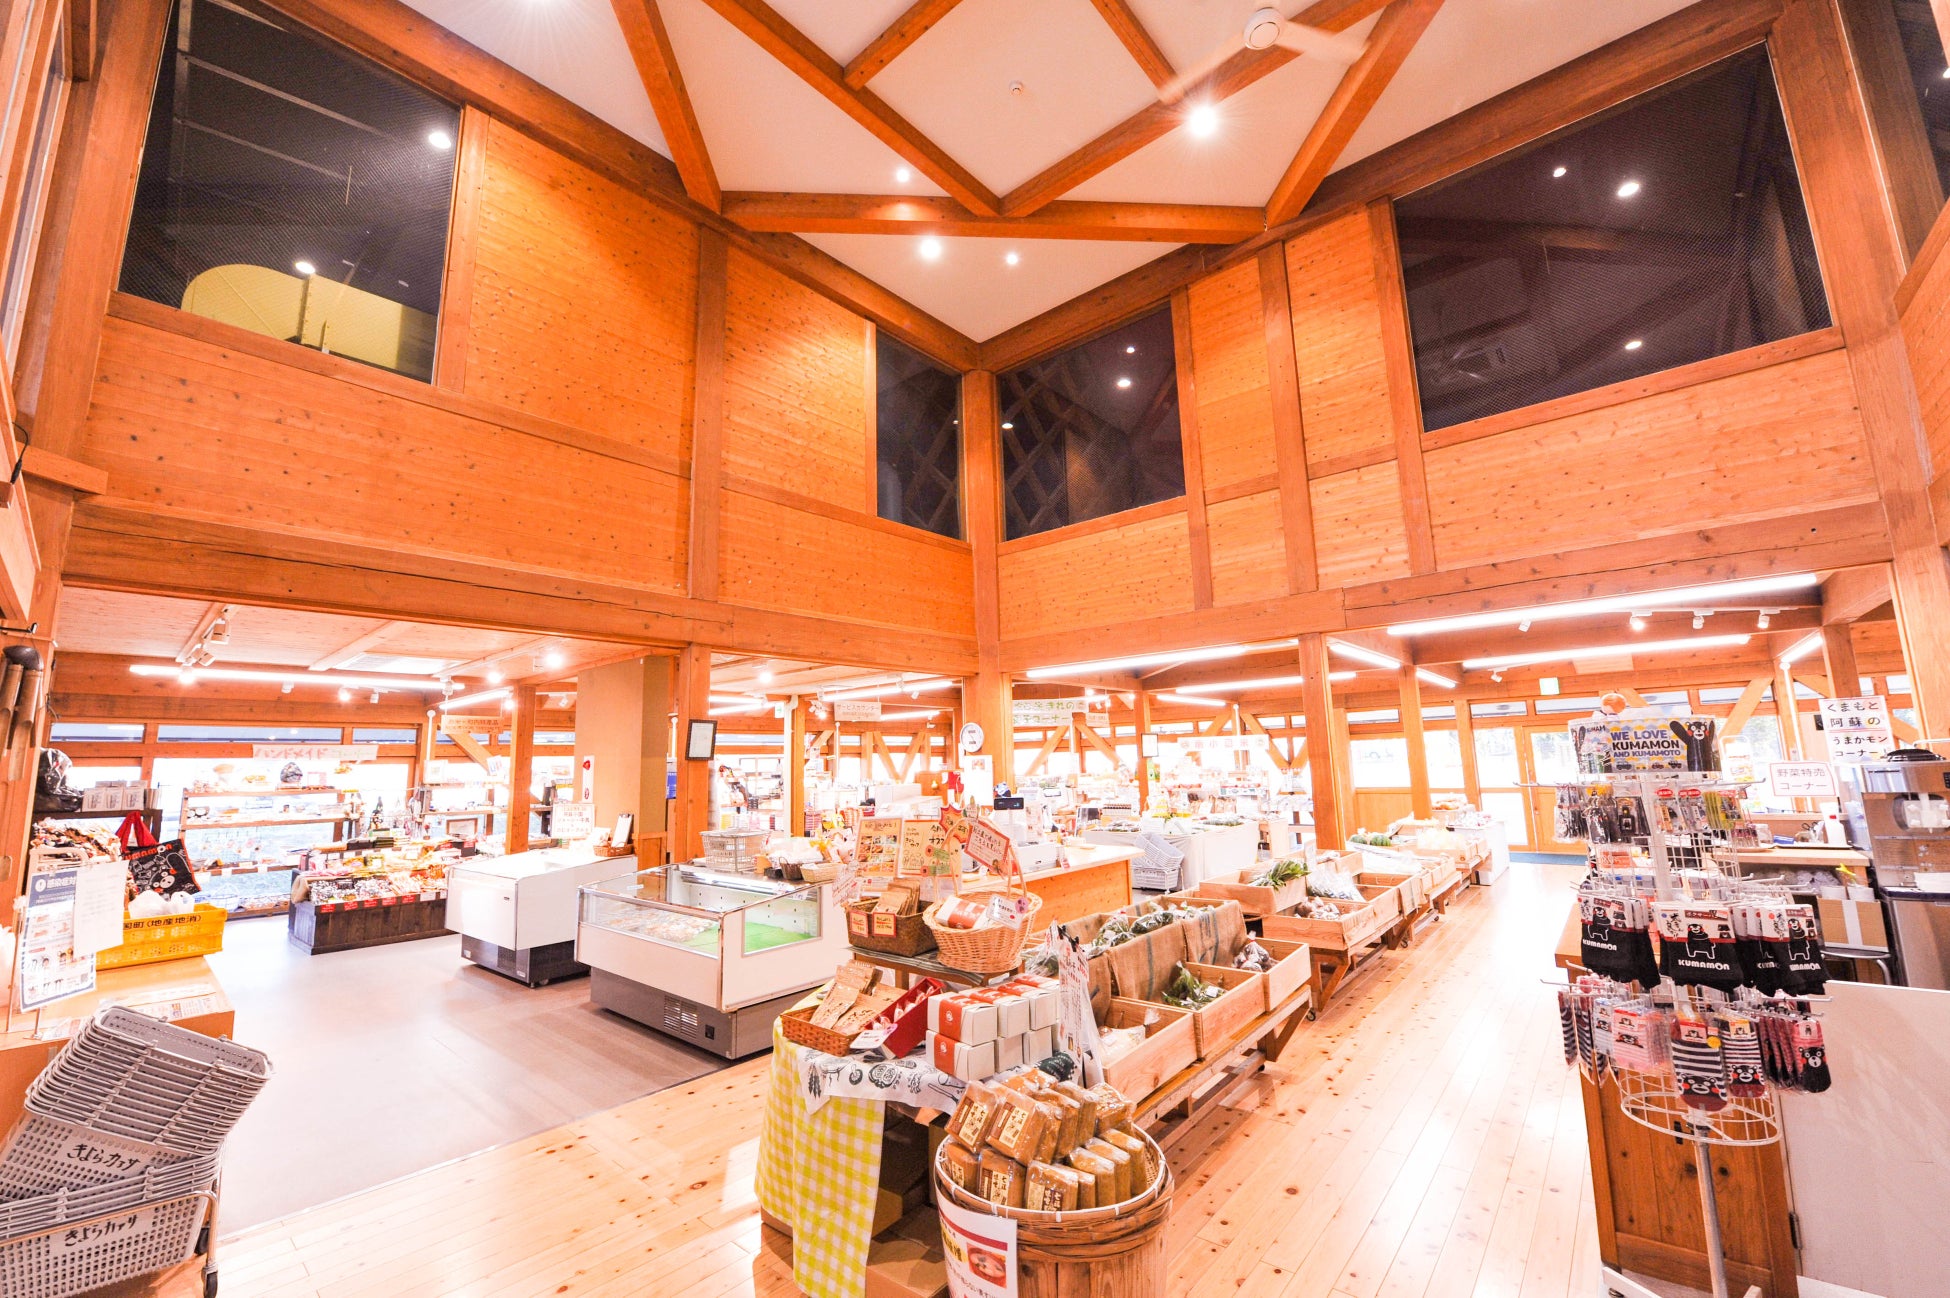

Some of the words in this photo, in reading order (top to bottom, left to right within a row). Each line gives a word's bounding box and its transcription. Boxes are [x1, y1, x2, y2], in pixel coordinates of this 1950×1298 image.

[1827, 701, 1879, 713] くまもと
[1830, 716, 1881, 728] 阿蘇の
[1611, 731, 1630, 741] WE
[1634, 729, 1668, 740] LOVE
[1833, 736, 1888, 745] うまかモン
[1612, 740, 1680, 751] KUMAMON
[254, 747, 329, 760] ハンドメイド
[1613, 750, 1630, 758] AND
[1632, 749, 1681, 757] KUMAMOTO
[1776, 767, 1826, 778] 野菜特売
[1780, 782, 1827, 791] コーナー
[1582, 938, 1618, 951] KUMAMON
[1678, 959, 1731, 971] KUMAMON
